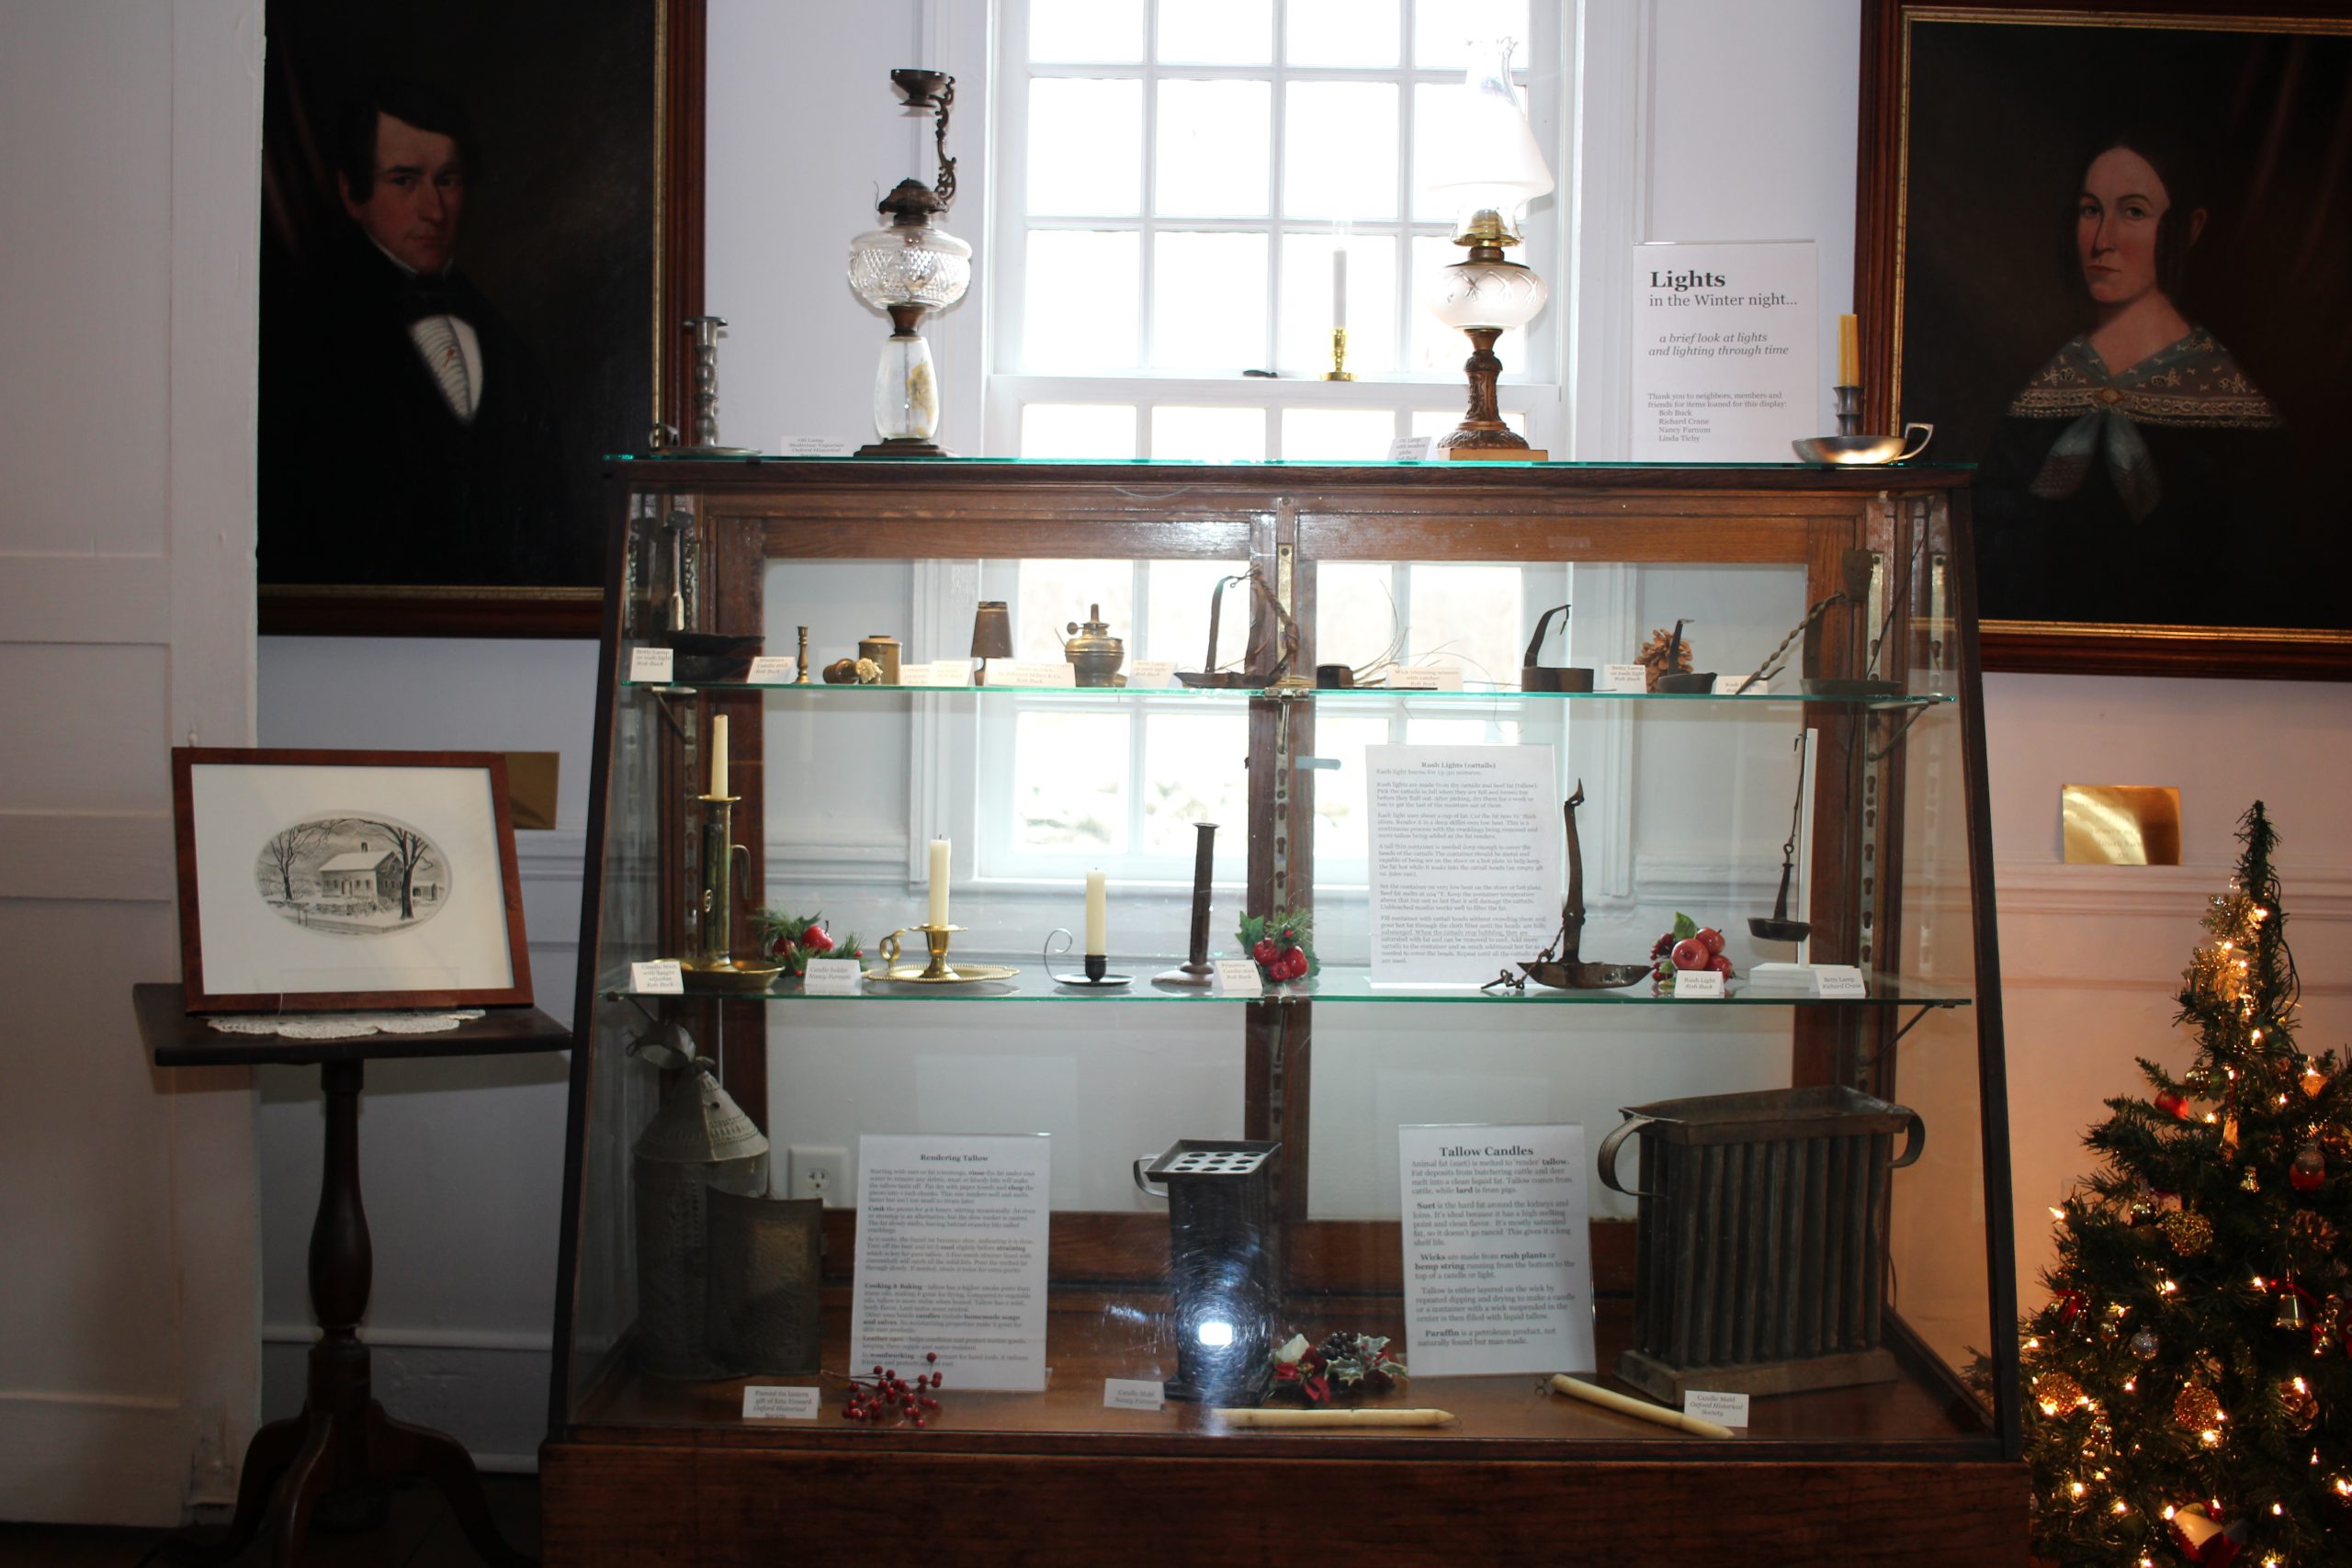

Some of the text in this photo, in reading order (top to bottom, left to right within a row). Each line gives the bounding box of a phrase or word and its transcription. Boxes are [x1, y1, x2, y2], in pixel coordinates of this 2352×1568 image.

[1650, 269, 1725, 292] Lights
[1650, 292, 1798, 309] in the Winter night...
[1669, 333, 1697, 344] brief
[1698, 333, 1721, 343] look
[1723, 333, 1736, 342] at
[1737, 332, 1769, 344] lights
[1648, 344, 1789, 358] and lighting through time
[1696, 392, 1733, 401] neighbors,
[1659, 426, 1680, 434] Nancy
[1421, 761, 1440, 769] Rush
[1442, 761, 1463, 771] Lights
[1440, 1145, 1535, 1156] Tallow Candles
[920, 1154, 961, 1163] Rendering
[1542, 1157, 1570, 1166] tallow.
[1521, 1251, 1547, 1259] plants
[1415, 1262, 1439, 1270] hemp
[1441, 1262, 1465, 1270] string
[1690, 1402, 1713, 1410] Oxford
